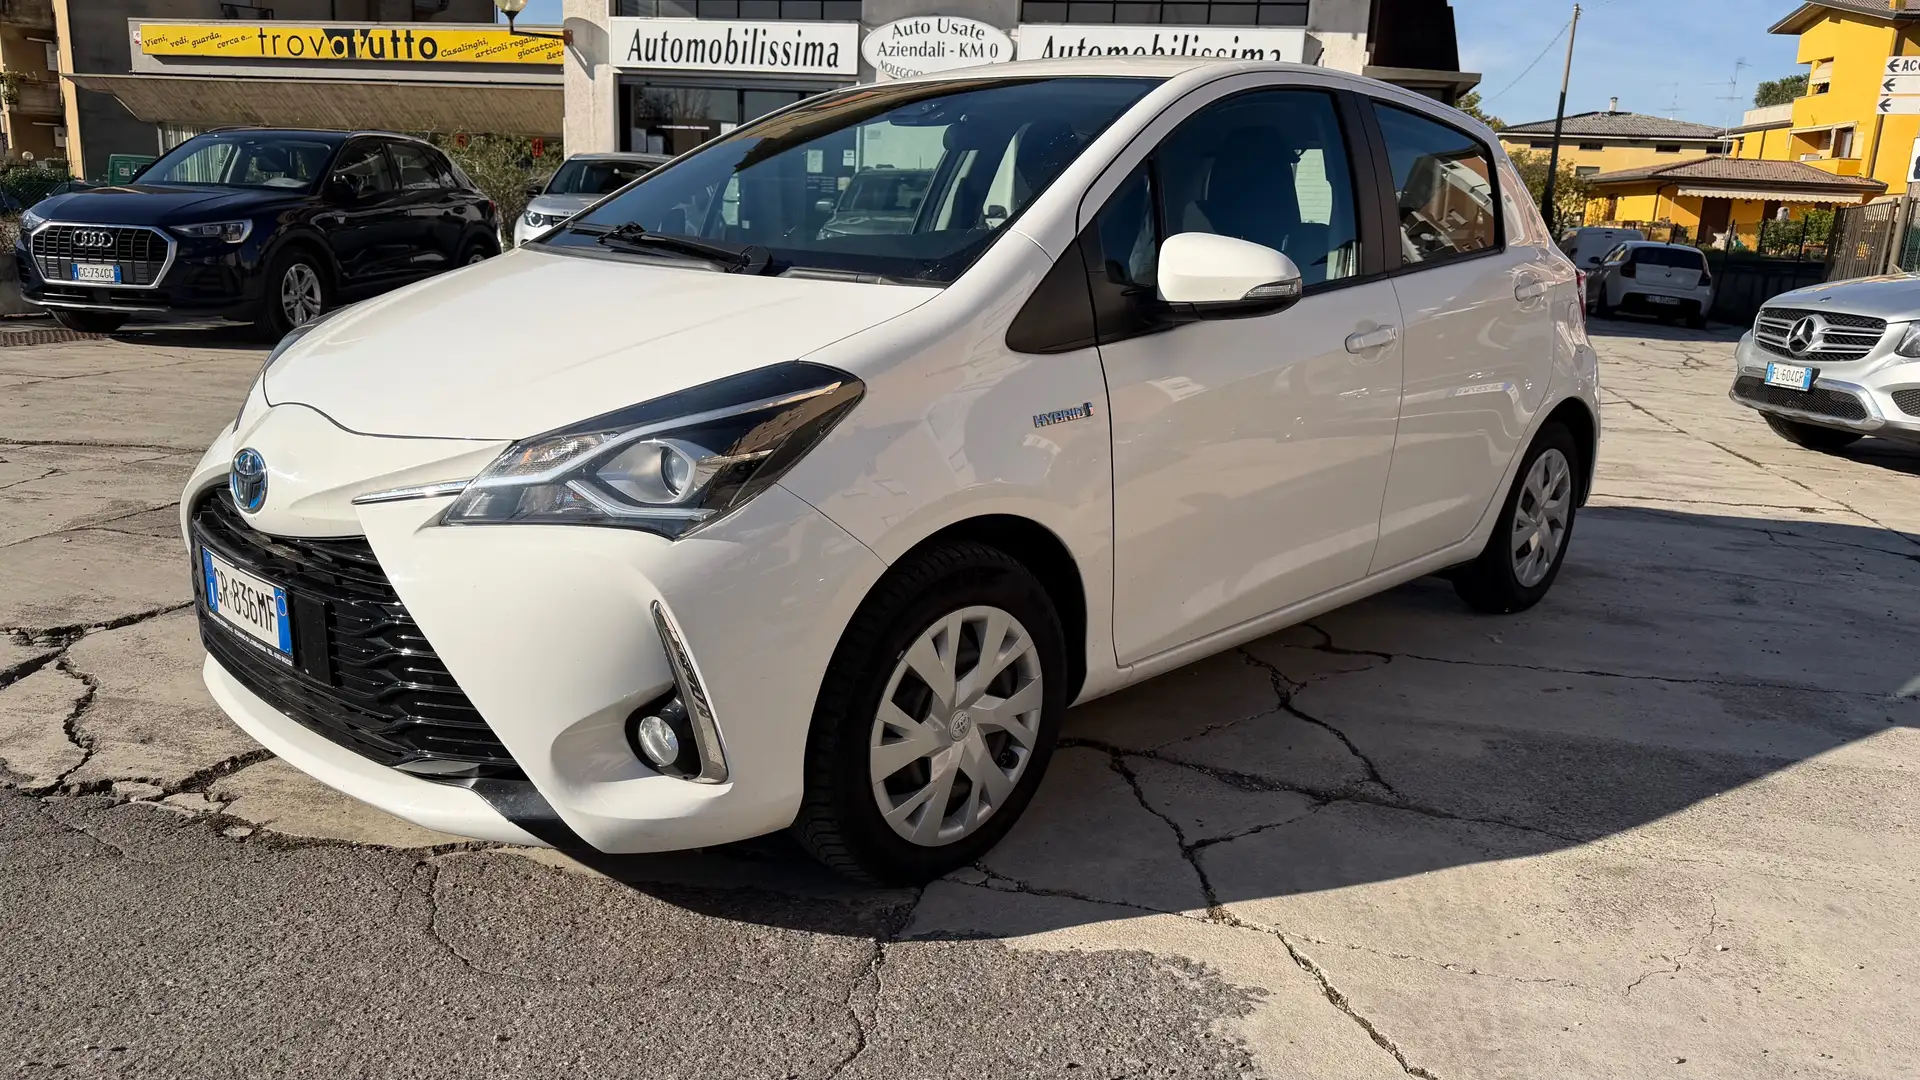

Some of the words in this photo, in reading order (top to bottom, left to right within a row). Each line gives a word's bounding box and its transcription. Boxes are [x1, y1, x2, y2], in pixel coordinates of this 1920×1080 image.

[892, 20, 931, 40] Auto
[937, 18, 986, 41] Usate
[144, 34, 168, 48] Vieni,
[169, 36, 190, 48] vedi,
[191, 32, 222, 49] guarda,
[216, 37, 240, 49] cerca
[258, 27, 438, 60] trovatutto
[440, 37, 489, 57] Casalinghi,
[517, 39, 562, 60] giocattoli,
[626, 28, 839, 68] Automobilissima
[876, 41, 945, 58] Aziendali
[959, 43, 984, 58] KM
[989, 43, 998, 59] 0
[475, 45, 508, 59] articoli
[1901, 59, 1920, 71] AC
[1033, 407, 1085, 428] HYBRID
